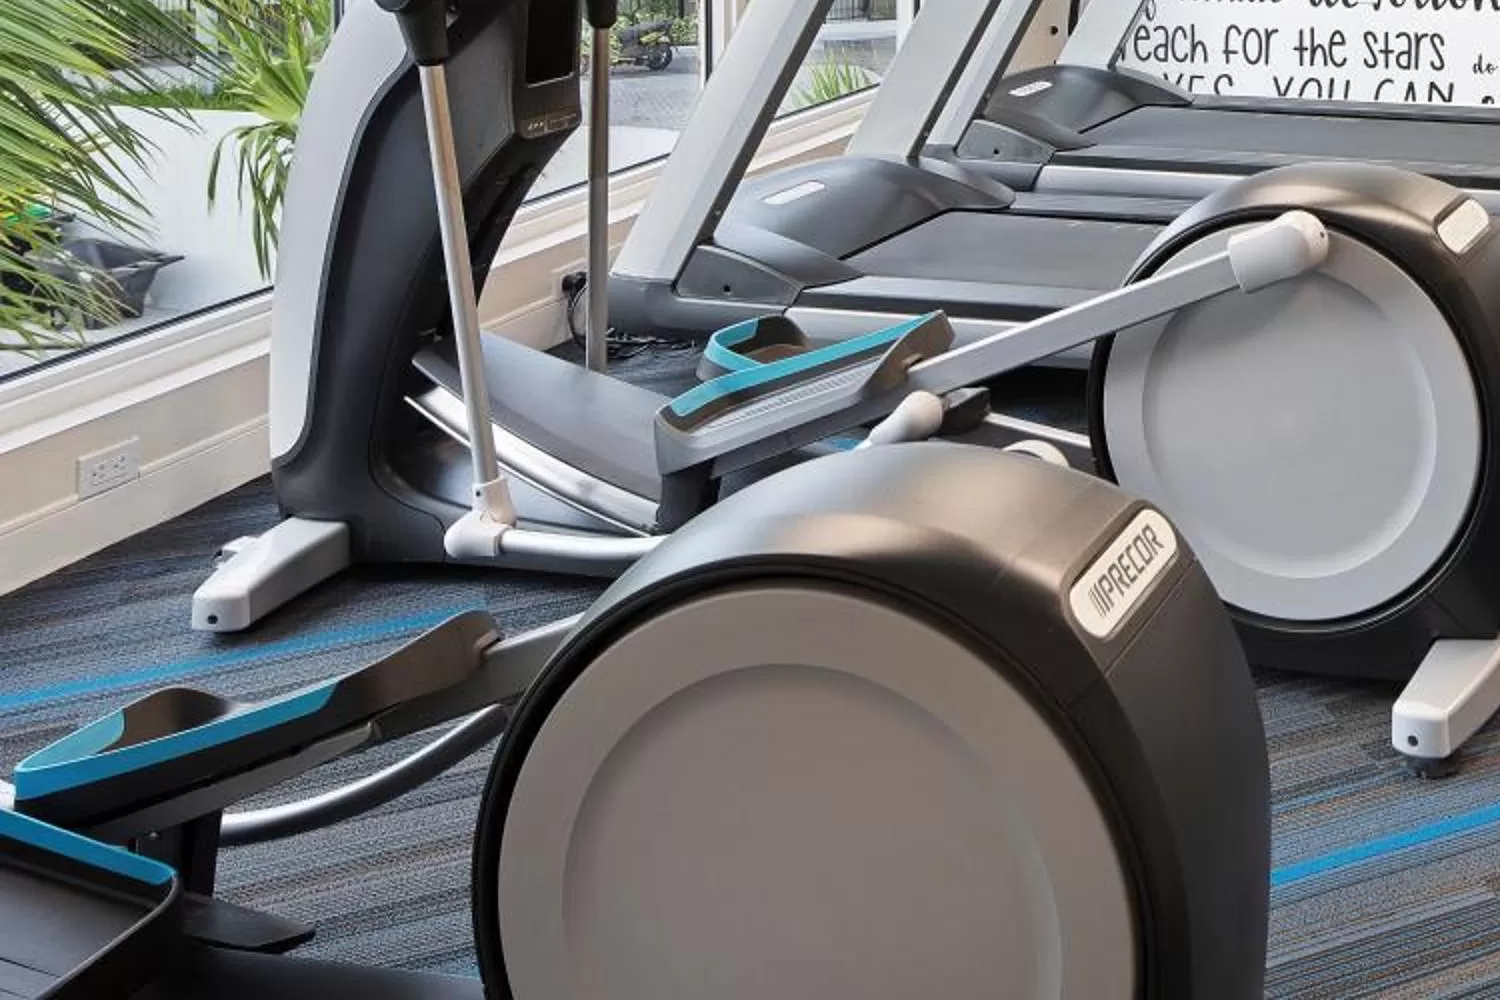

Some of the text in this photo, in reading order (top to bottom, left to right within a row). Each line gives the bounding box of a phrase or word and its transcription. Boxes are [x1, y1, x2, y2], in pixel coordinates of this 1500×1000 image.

[1132, 23, 1446, 71] each for the stars
[1473, 53, 1495, 75] do
[1097, 524, 1165, 608] PRECOR
